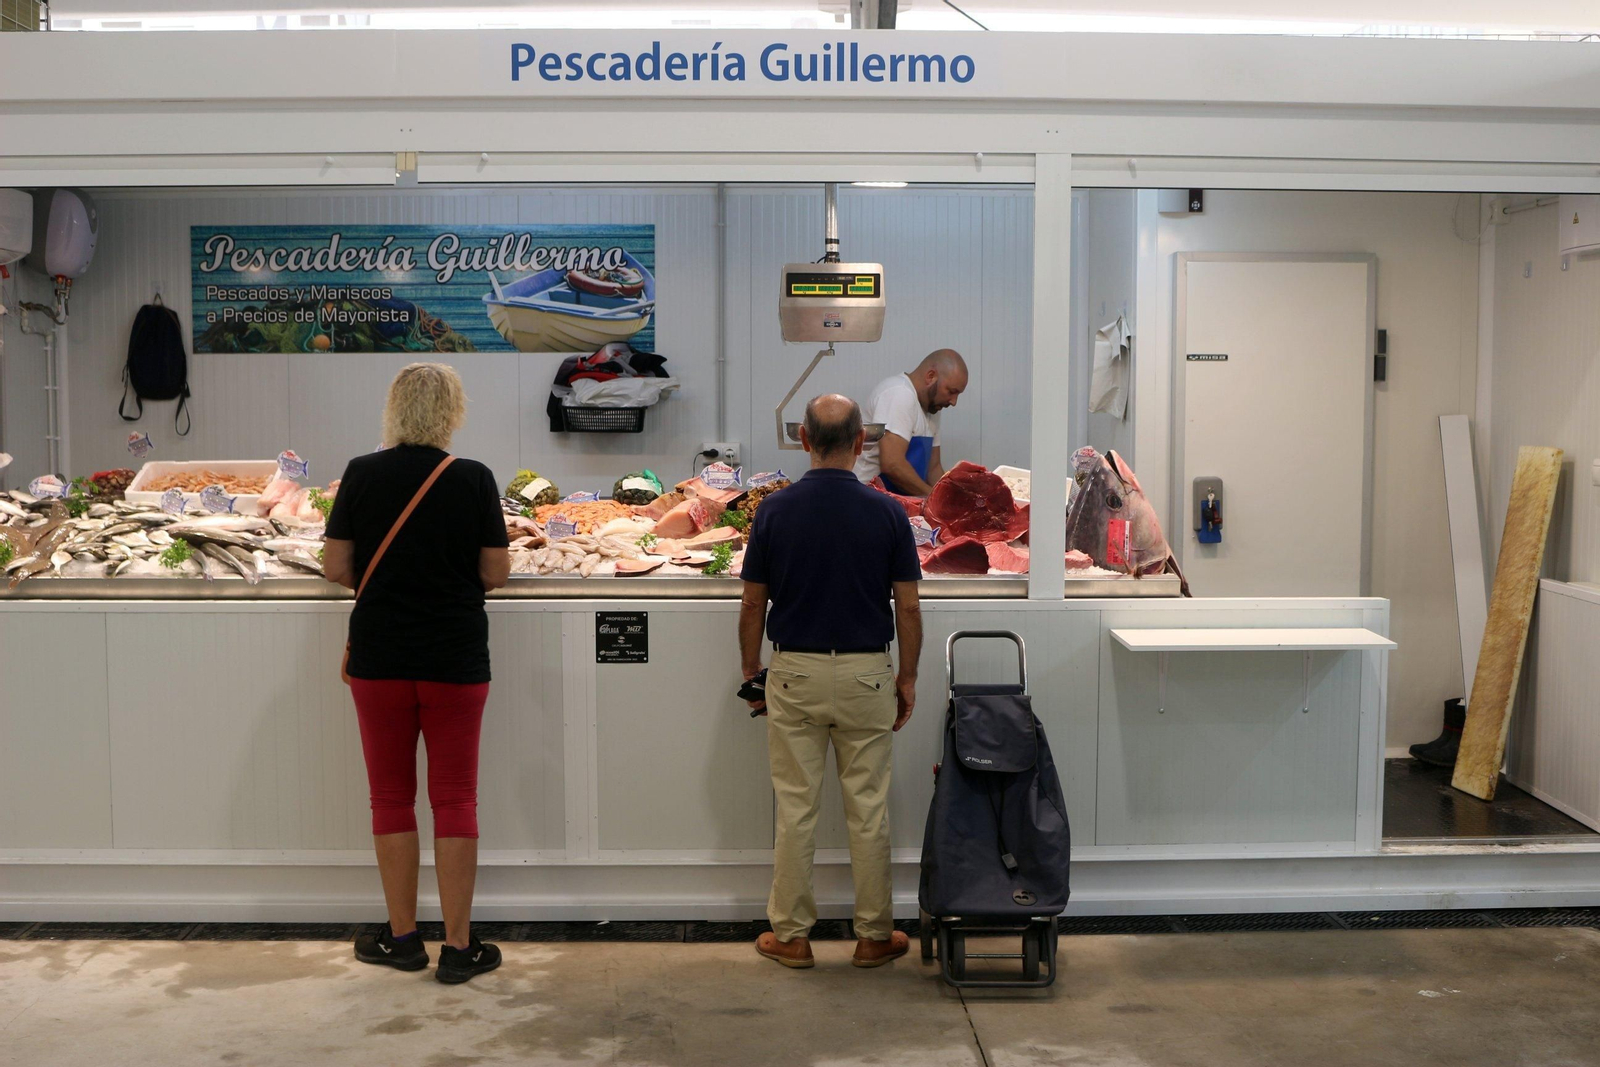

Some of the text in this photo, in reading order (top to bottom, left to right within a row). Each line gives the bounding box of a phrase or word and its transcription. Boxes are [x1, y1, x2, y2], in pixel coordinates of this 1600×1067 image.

[510, 41, 976, 83] Pescadería Guillermo
[200, 232, 627, 284] Pescadería Guillermo
[206, 285, 392, 304] Pescados y Mariscos
[206, 307, 409, 326] a Precios de Mayorista
